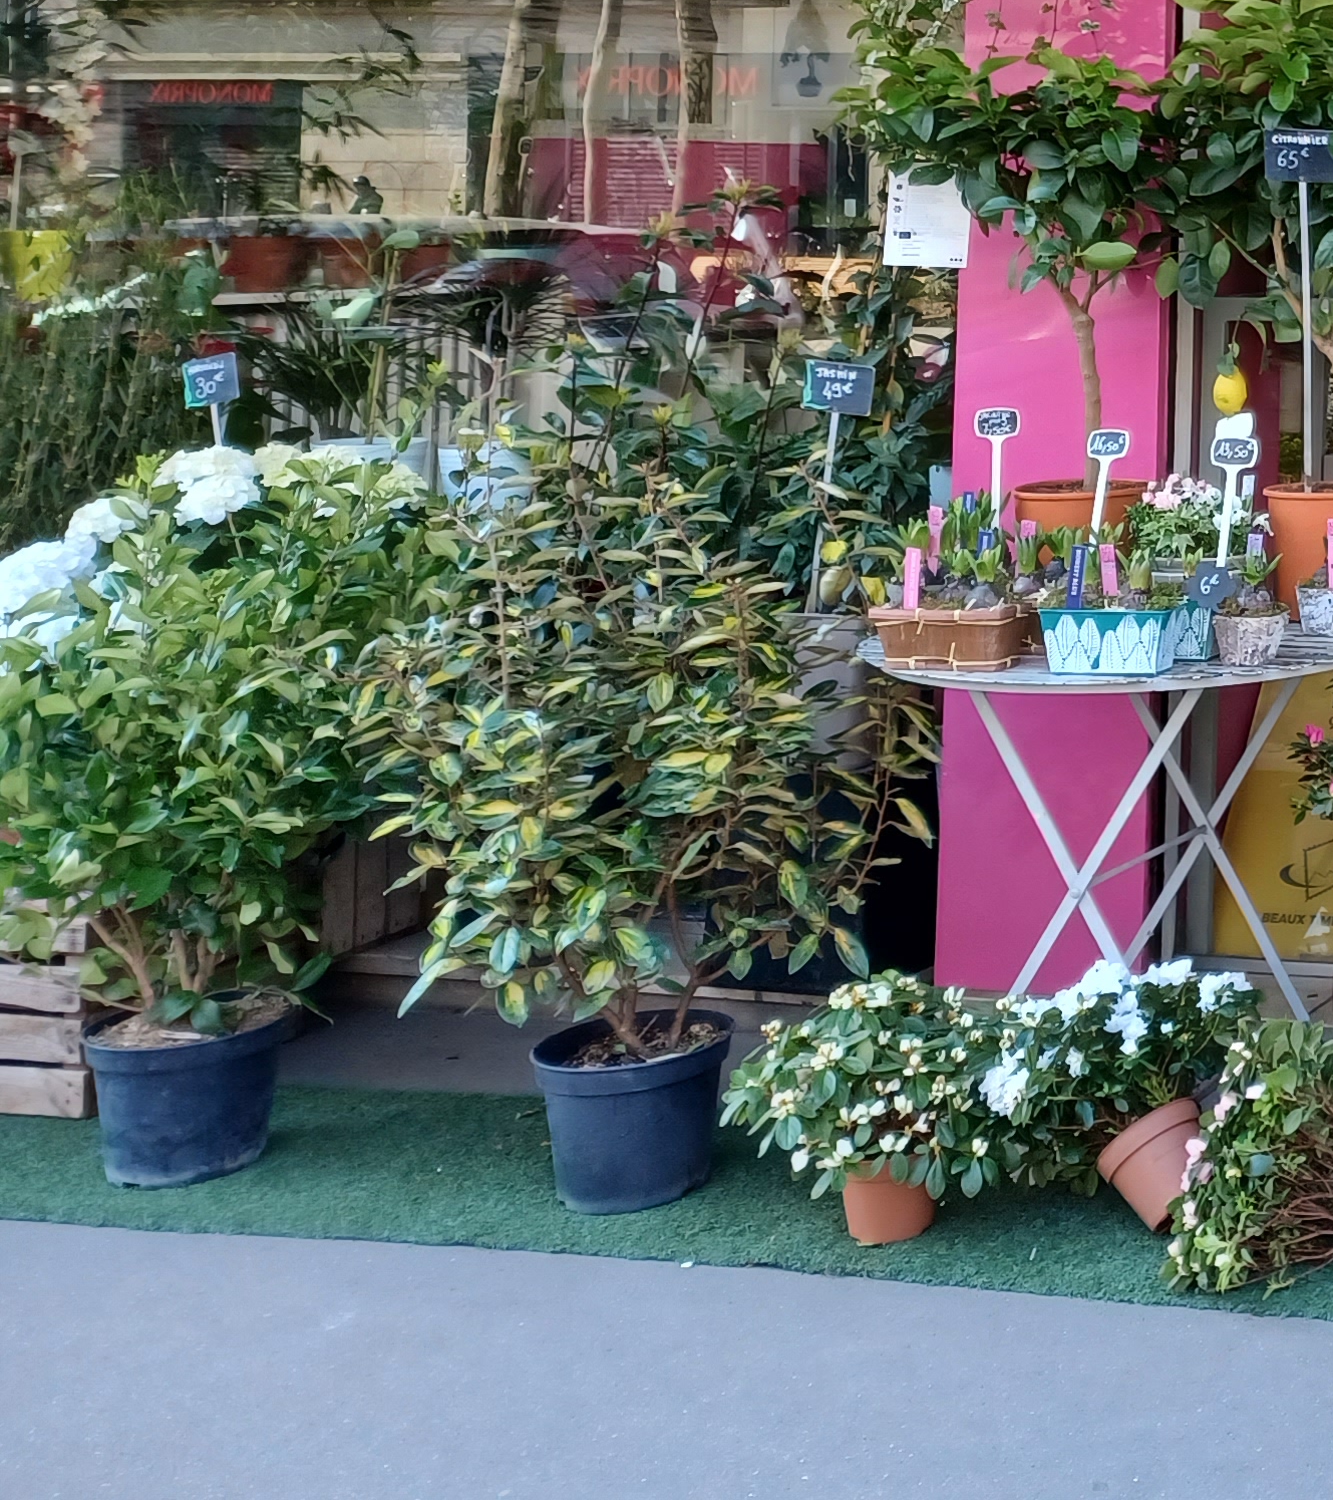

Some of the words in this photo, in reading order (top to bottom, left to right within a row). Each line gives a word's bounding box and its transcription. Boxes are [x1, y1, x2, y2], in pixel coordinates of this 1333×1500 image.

[1277, 147, 1310, 169] 65€
[195, 370, 225, 399] 30€
[1200, 573, 1220, 595] 6€
[1261, 912, 1307, 925] BEAUX
